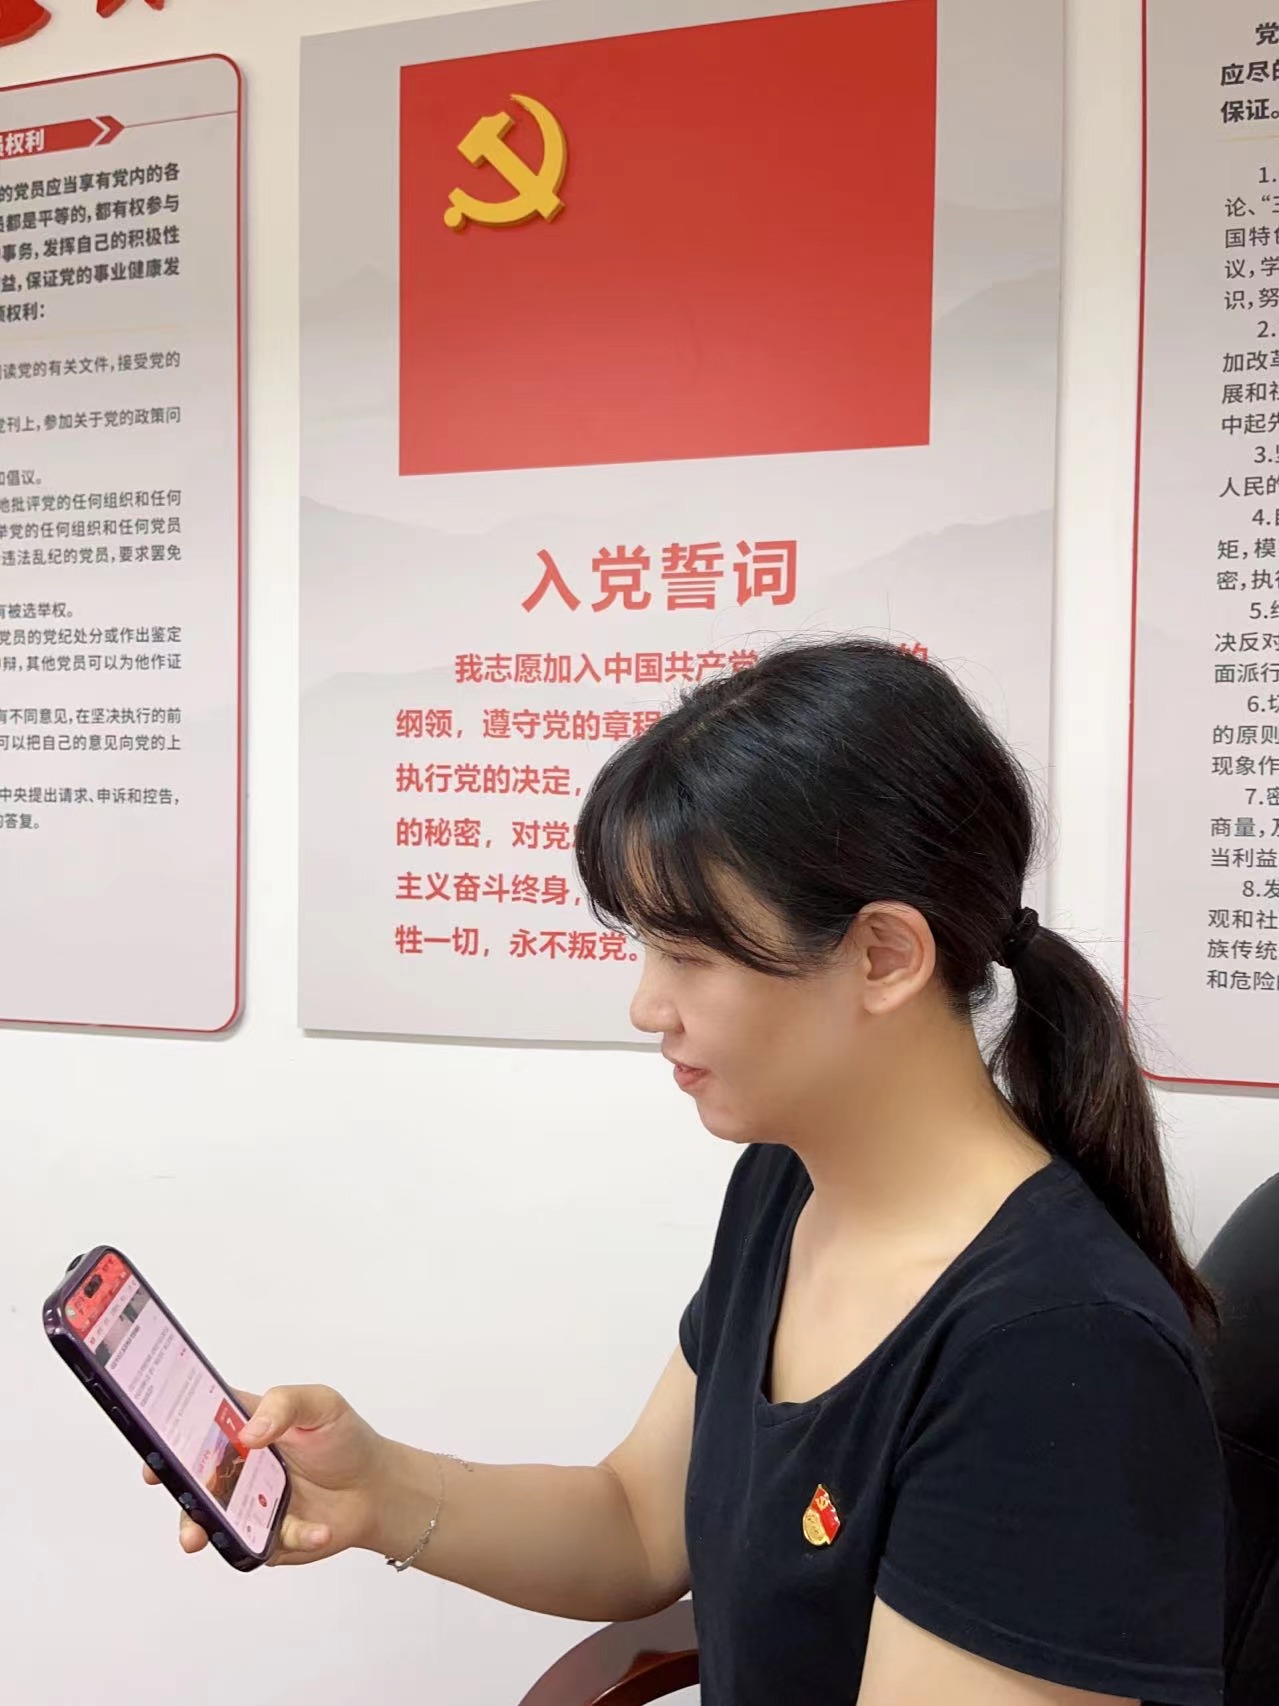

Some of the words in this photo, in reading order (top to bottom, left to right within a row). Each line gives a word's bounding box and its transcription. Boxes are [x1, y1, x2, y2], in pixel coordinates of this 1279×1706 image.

[1256, 22, 1279, 46] 党
[1220, 98, 1279, 123] 保证。
[0, 127, 44, 155] 权利
[1258, 167, 1276, 183] 1.
[0, 194, 179, 232] 都是平等的，都有权参与
[1225, 226, 1279, 248] 国特
[1257, 321, 1276, 338] 2.
[0, 350, 180, 380] 读党的有关文件，接受党的
[1254, 445, 1279, 463] 3.
[1252, 508, 1279, 526] 4.
[521, 540, 798, 613] 入党誓词
[1217, 569, 1279, 591] 密，执
[0, 653, 182, 671] 辩，其他党员可以为他作证
[1215, 663, 1279, 683] 面派行
[1211, 756, 1279, 776] 现象作
[395, 764, 582, 797] 执行党的决定，
[0, 813, 39, 829] 答复。
[396, 818, 577, 851] 的秘密，对党
[1211, 847, 1277, 868] 当利益
[395, 872, 582, 906] 主义奋斗终身，
[1208, 909, 1279, 929] 观和社
[395, 925, 638, 961] 牲一切，永不叛党。
[1207, 939, 1277, 960] 族传统
[1206, 970, 1279, 991] 和危险
